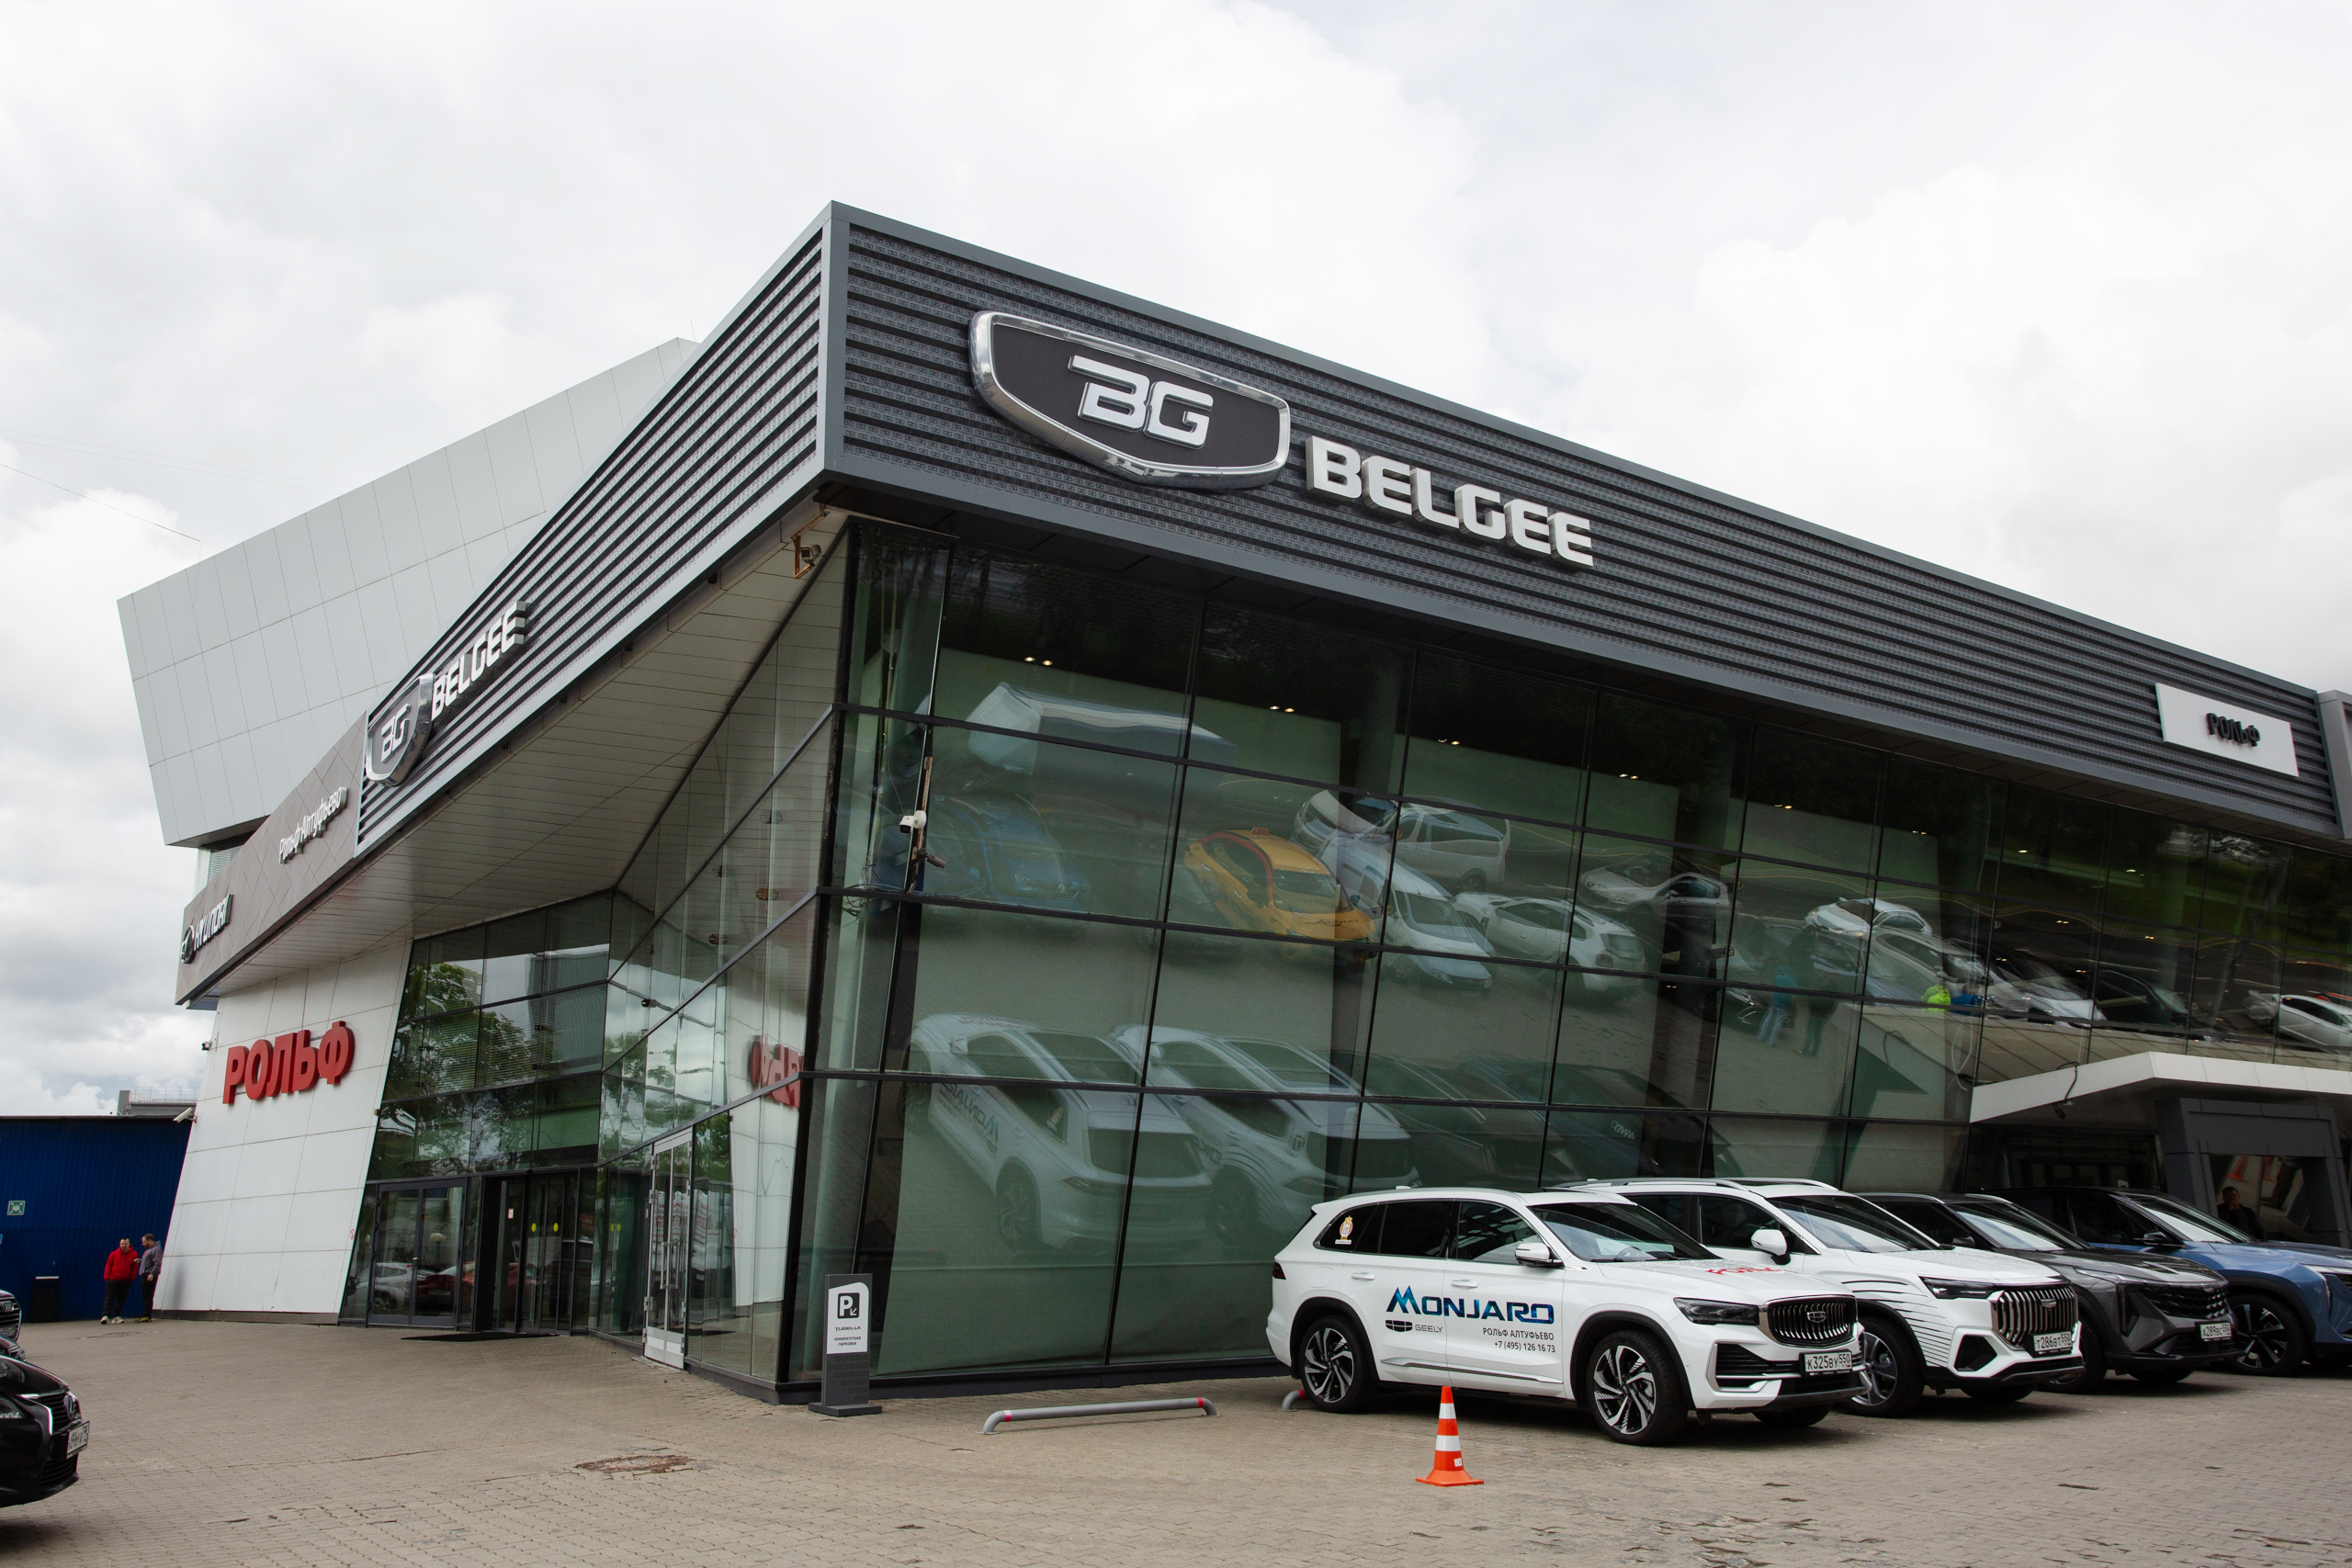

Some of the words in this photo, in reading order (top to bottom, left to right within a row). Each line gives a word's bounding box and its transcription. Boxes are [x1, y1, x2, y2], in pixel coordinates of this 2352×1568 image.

[1068, 355, 1214, 450] BG
[1306, 435, 1594, 568] BELGEE
[431, 601, 526, 721] BELGEE
[2206, 712, 2261, 748] РОЛЬФ
[193, 894, 233, 952] HYUNDAI
[222, 1020, 355, 1105] РОЛЬФ
[1385, 1284, 1555, 1325] MONJARO
[1415, 1324, 1443, 1333] GEELY
[1482, 1327, 1509, 1337] РОЛЬФ
[1510, 1329, 1555, 1341] АЛТУФЬЕВО
[1494, 1340, 1503, 1349] +7
[1503, 1341, 1521, 1352] (495)
[1522, 1342, 1536, 1351] 126
[1537, 1344, 1546, 1352] 16
[1546, 1344, 1556, 1354] 73
[1838, 1353, 1850, 1364] 550
